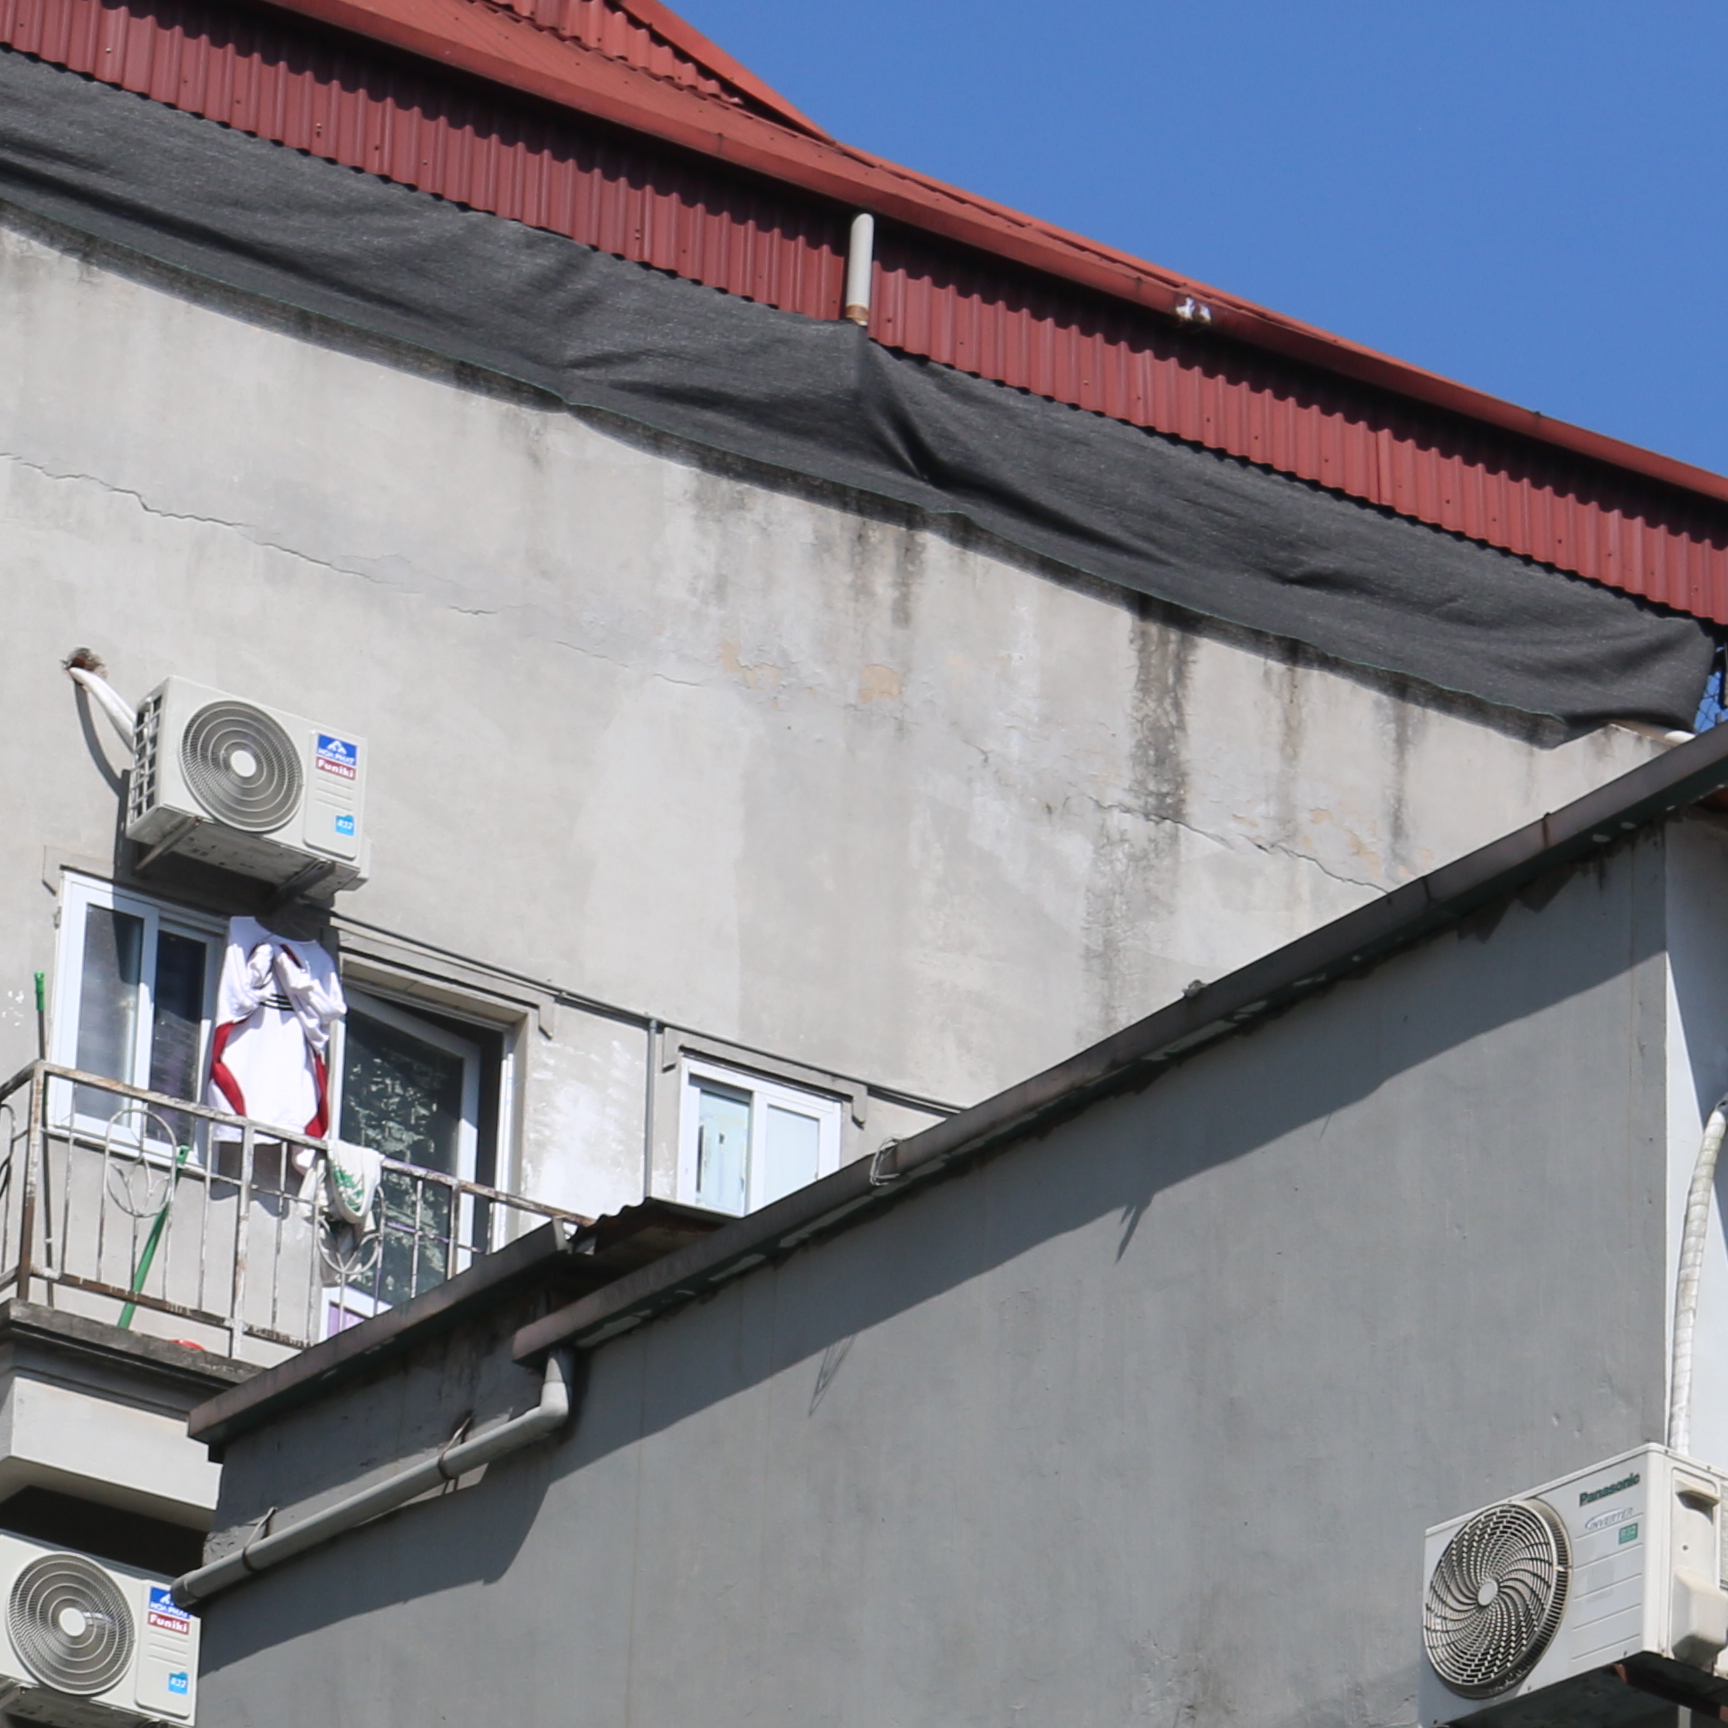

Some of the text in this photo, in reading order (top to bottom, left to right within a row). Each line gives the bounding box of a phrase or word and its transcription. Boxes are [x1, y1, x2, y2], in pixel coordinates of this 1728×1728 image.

[318, 759, 353, 778] Funiki
[1579, 1472, 1640, 1507] Panasonic
[149, 1614, 187, 1632] Funiki
